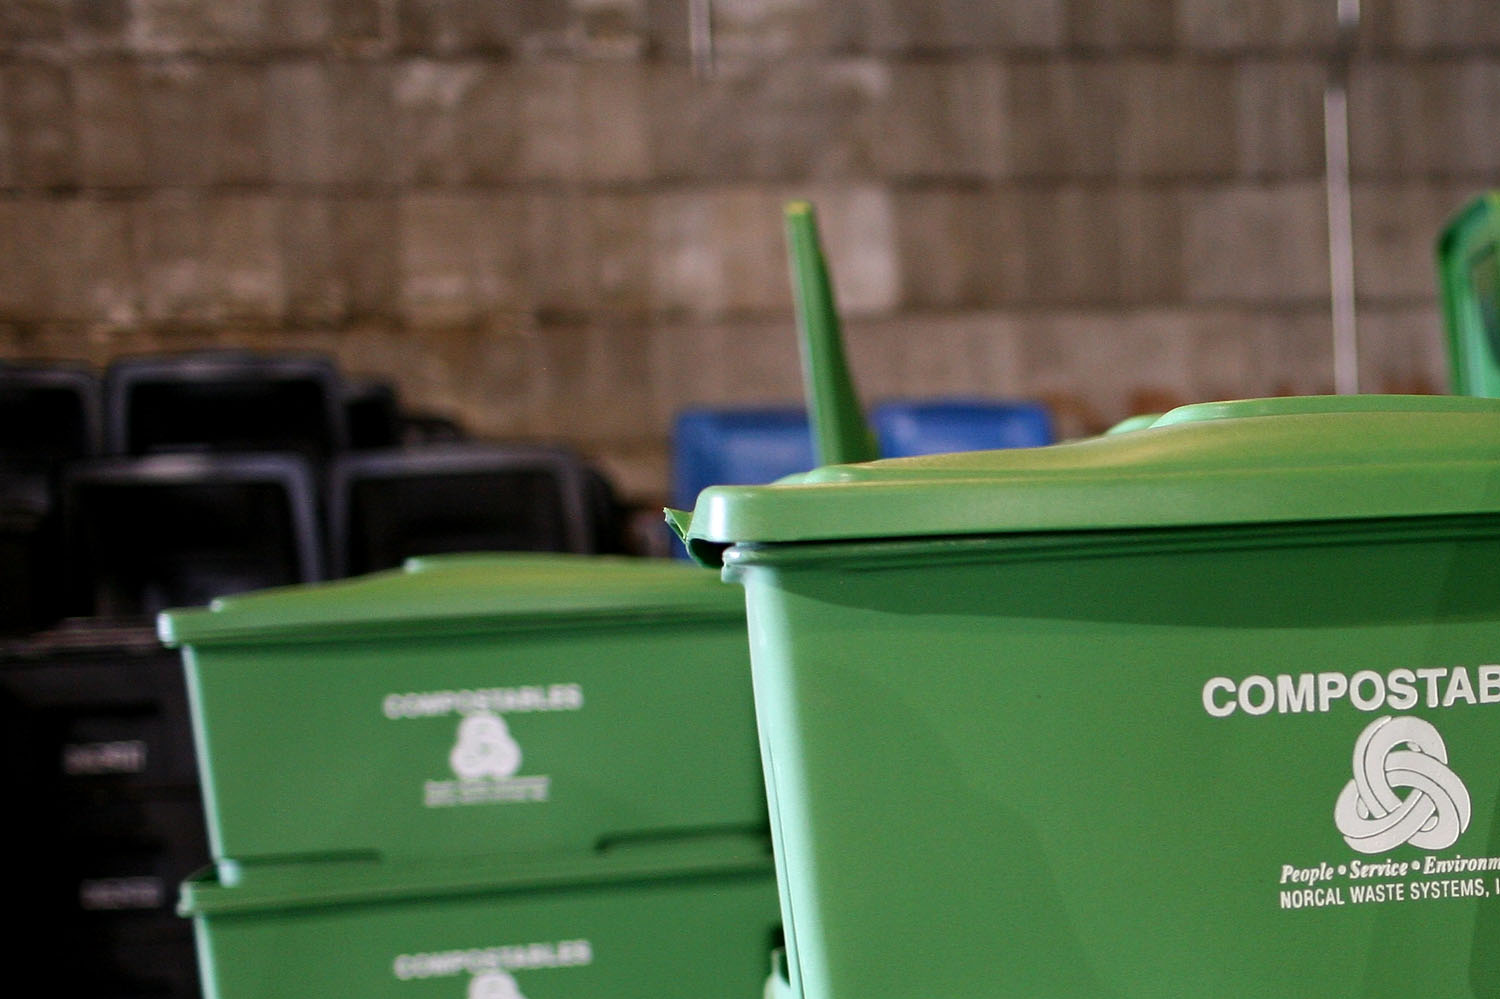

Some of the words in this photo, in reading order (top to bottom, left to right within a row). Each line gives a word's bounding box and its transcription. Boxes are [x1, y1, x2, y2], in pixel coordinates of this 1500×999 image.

[1279, 861, 1335, 887] People
[1349, 858, 1409, 879] Service
[1280, 888, 1346, 909] NORCAL
[1349, 884, 1405, 904] WASTE
[1409, 879, 1490, 900] SYSTEMS,
